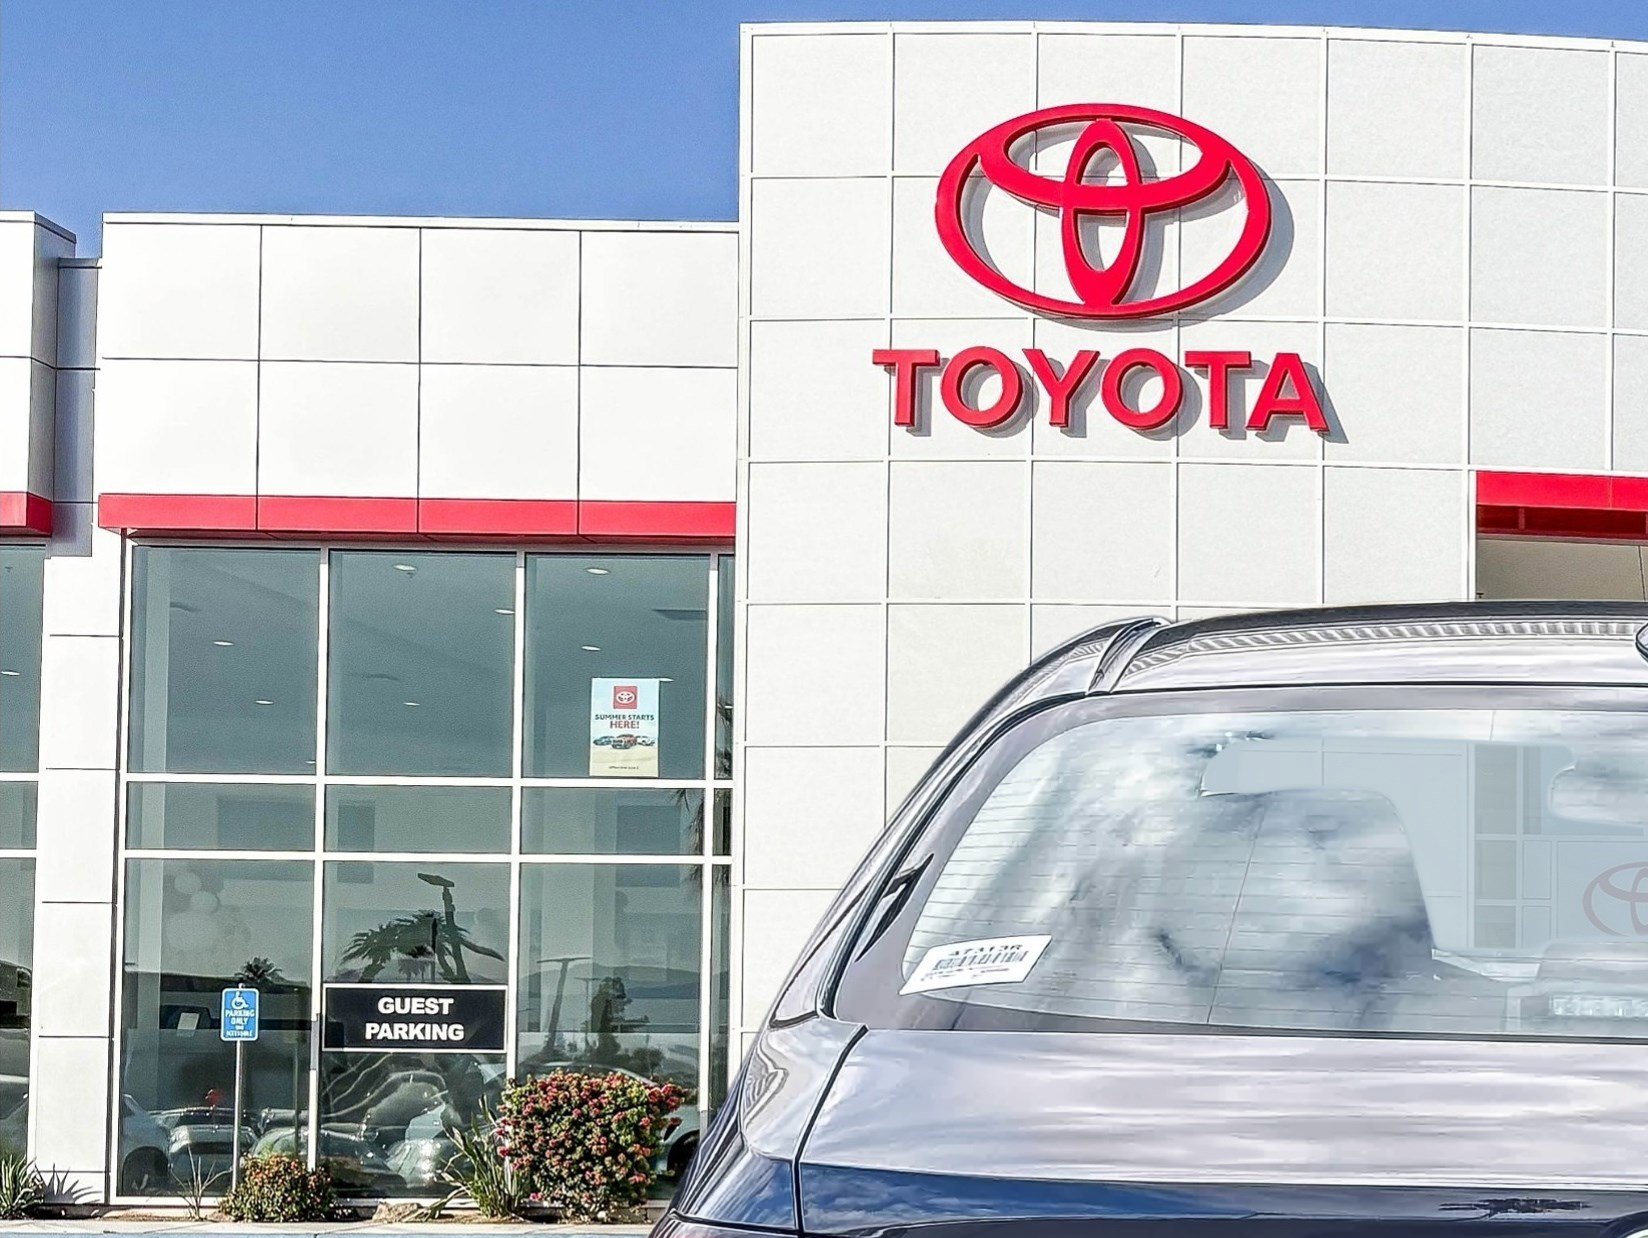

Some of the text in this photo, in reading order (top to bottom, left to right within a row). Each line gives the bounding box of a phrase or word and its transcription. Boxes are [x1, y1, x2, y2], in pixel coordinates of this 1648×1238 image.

[872, 346, 1331, 434] TOYOTA
[609, 720, 640, 729] HERE!
[225, 1009, 255, 1018] PARKING
[377, 997, 455, 1015] GUEST
[365, 1022, 465, 1041] PARKING
